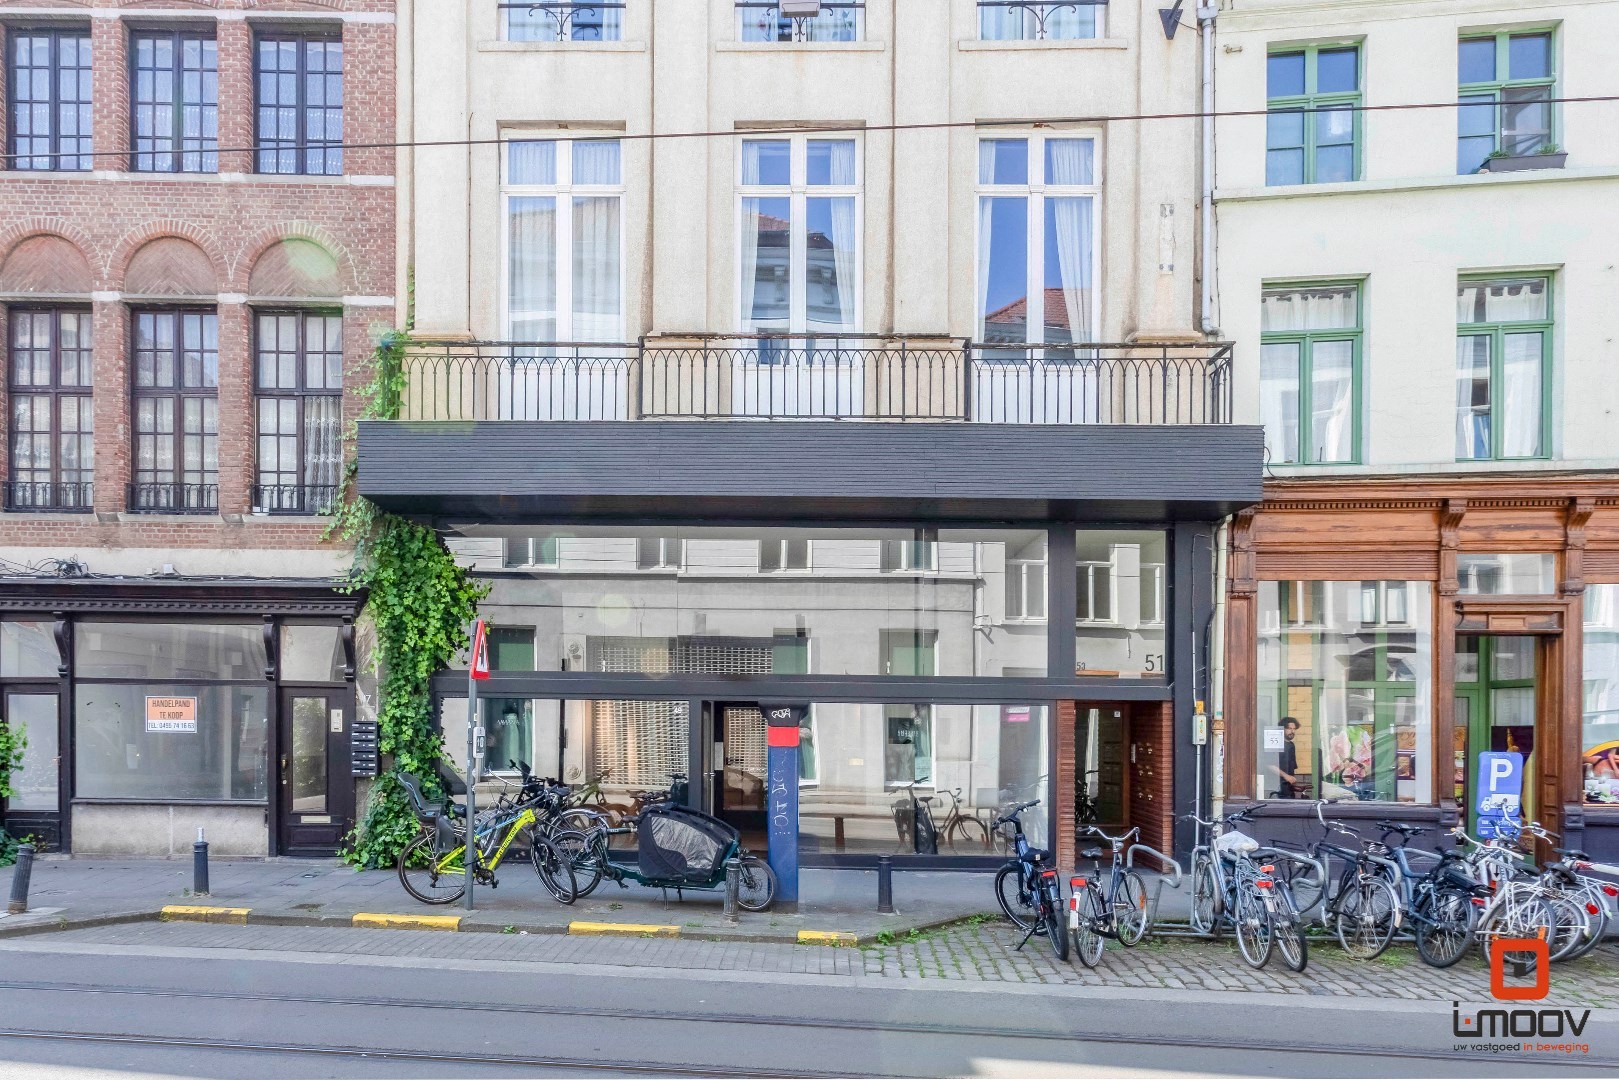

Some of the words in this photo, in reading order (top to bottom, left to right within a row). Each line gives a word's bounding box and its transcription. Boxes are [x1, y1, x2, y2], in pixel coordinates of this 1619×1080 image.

[1076, 662, 1085, 671] 53
[1145, 654, 1163, 672] 51
[152, 699, 190, 707] HANDELPAND
[159, 711, 166, 719] TE
[167, 711, 184, 719] KOOP
[1489, 758, 1513, 791] P
